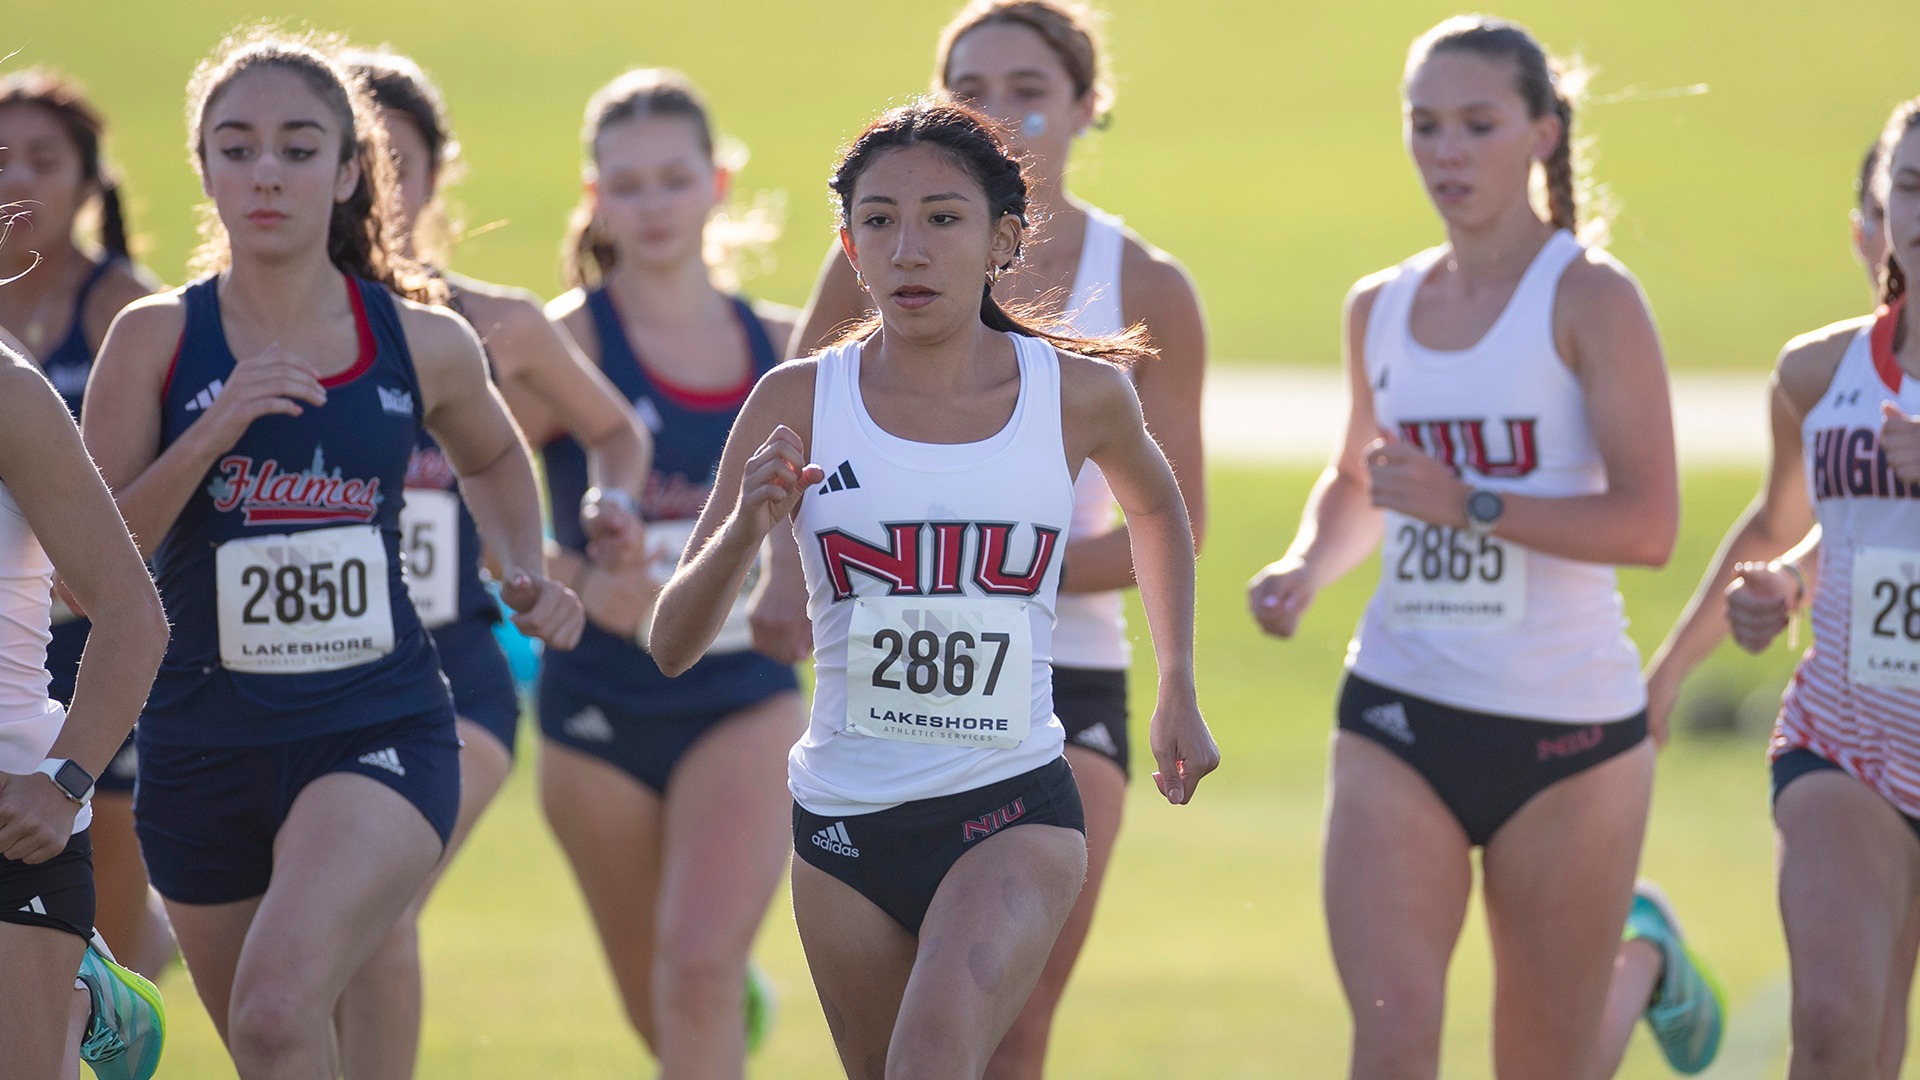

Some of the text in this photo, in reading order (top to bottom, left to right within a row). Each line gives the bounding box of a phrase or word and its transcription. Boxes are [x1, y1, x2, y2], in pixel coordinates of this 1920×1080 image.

[214, 454, 381, 513] Flames
[815, 520, 1062, 603] NIU
[1396, 524, 1504, 583] 2865
[241, 558, 368, 625] 2850
[242, 636, 374, 656] LAKESHORE
[872, 628, 1011, 697] 2867
[870, 706, 1009, 732] LAKESHORE
[883, 725, 936, 738] ATHLETIC
[962, 797, 1026, 842] NIU
[811, 833, 860, 859] adidas
